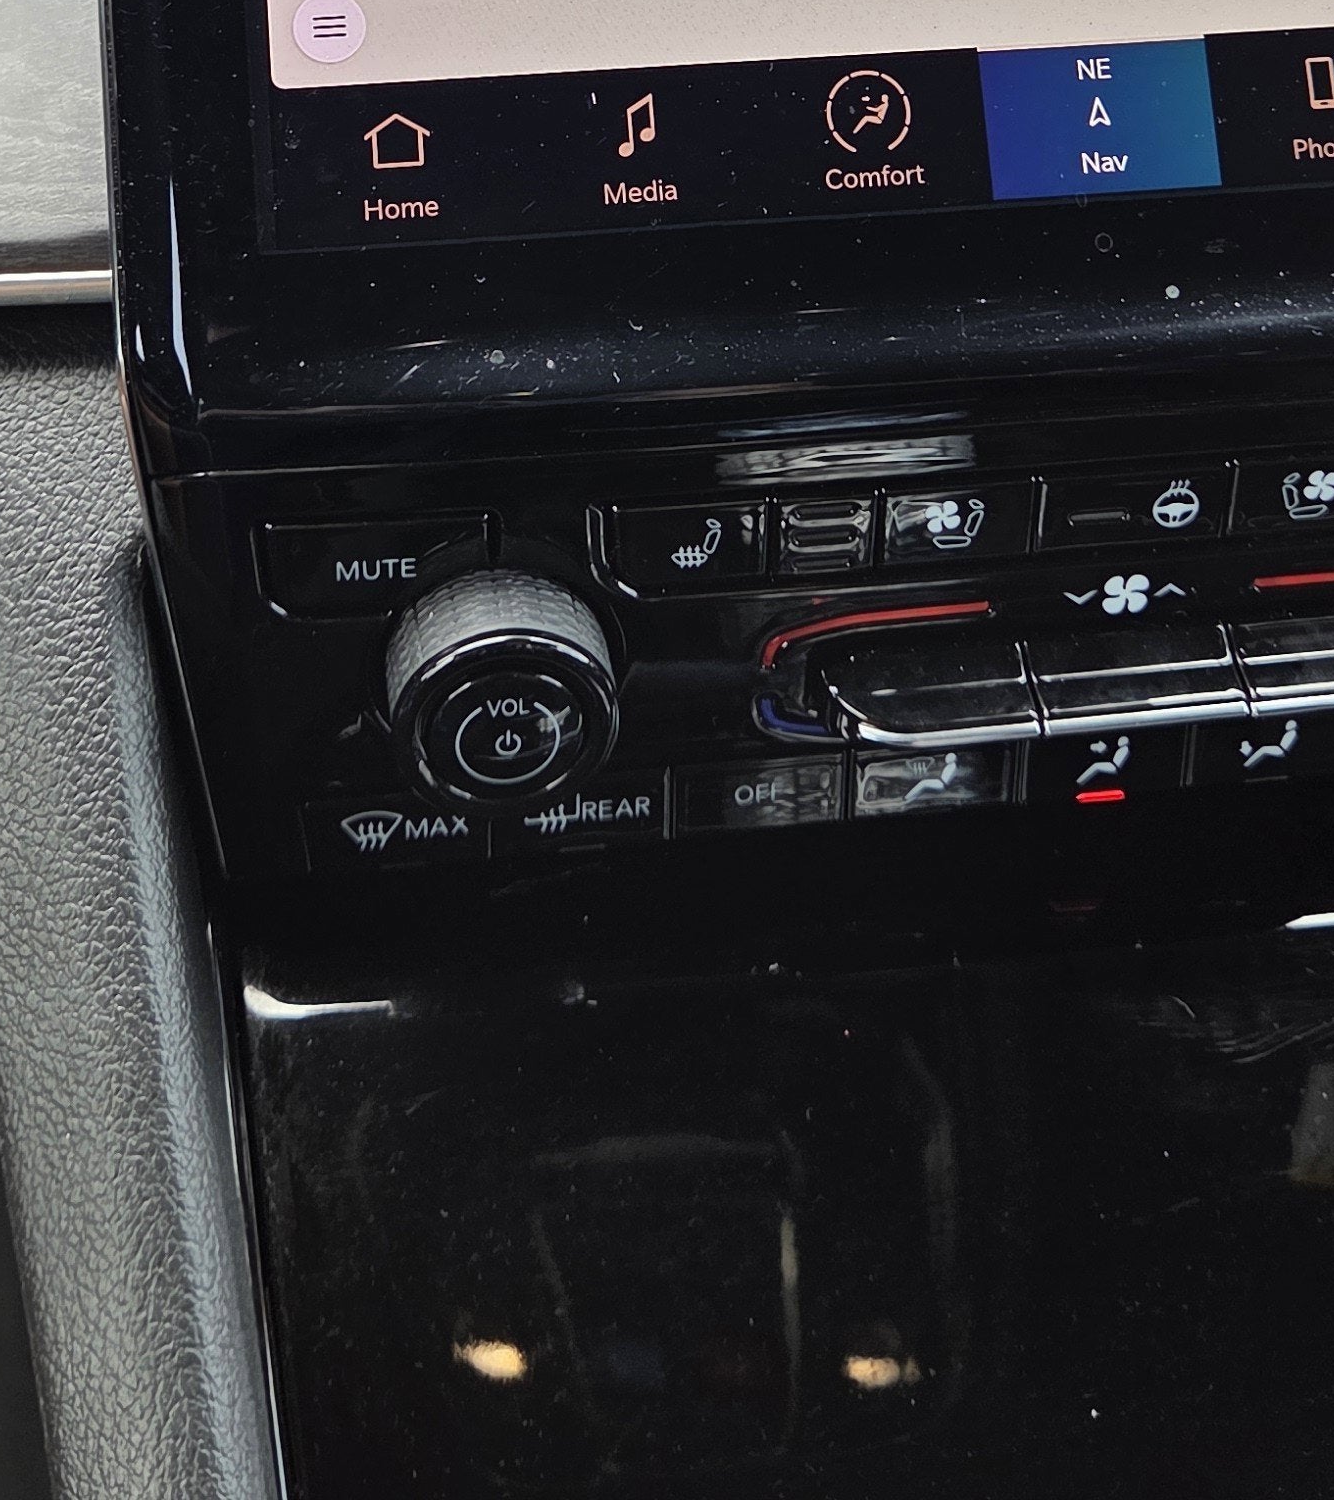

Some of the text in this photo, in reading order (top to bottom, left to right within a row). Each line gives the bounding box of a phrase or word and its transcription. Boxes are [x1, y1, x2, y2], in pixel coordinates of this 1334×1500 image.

[1077, 57, 1111, 81] NE
[1080, 150, 1128, 175] Nav
[824, 163, 926, 192] Comfort
[603, 180, 678, 206] Media
[363, 196, 440, 222] Home
[335, 557, 417, 582] MUTE
[487, 699, 529, 717] VOL
[584, 797, 650, 821] REAR
[405, 816, 468, 842] MAX
